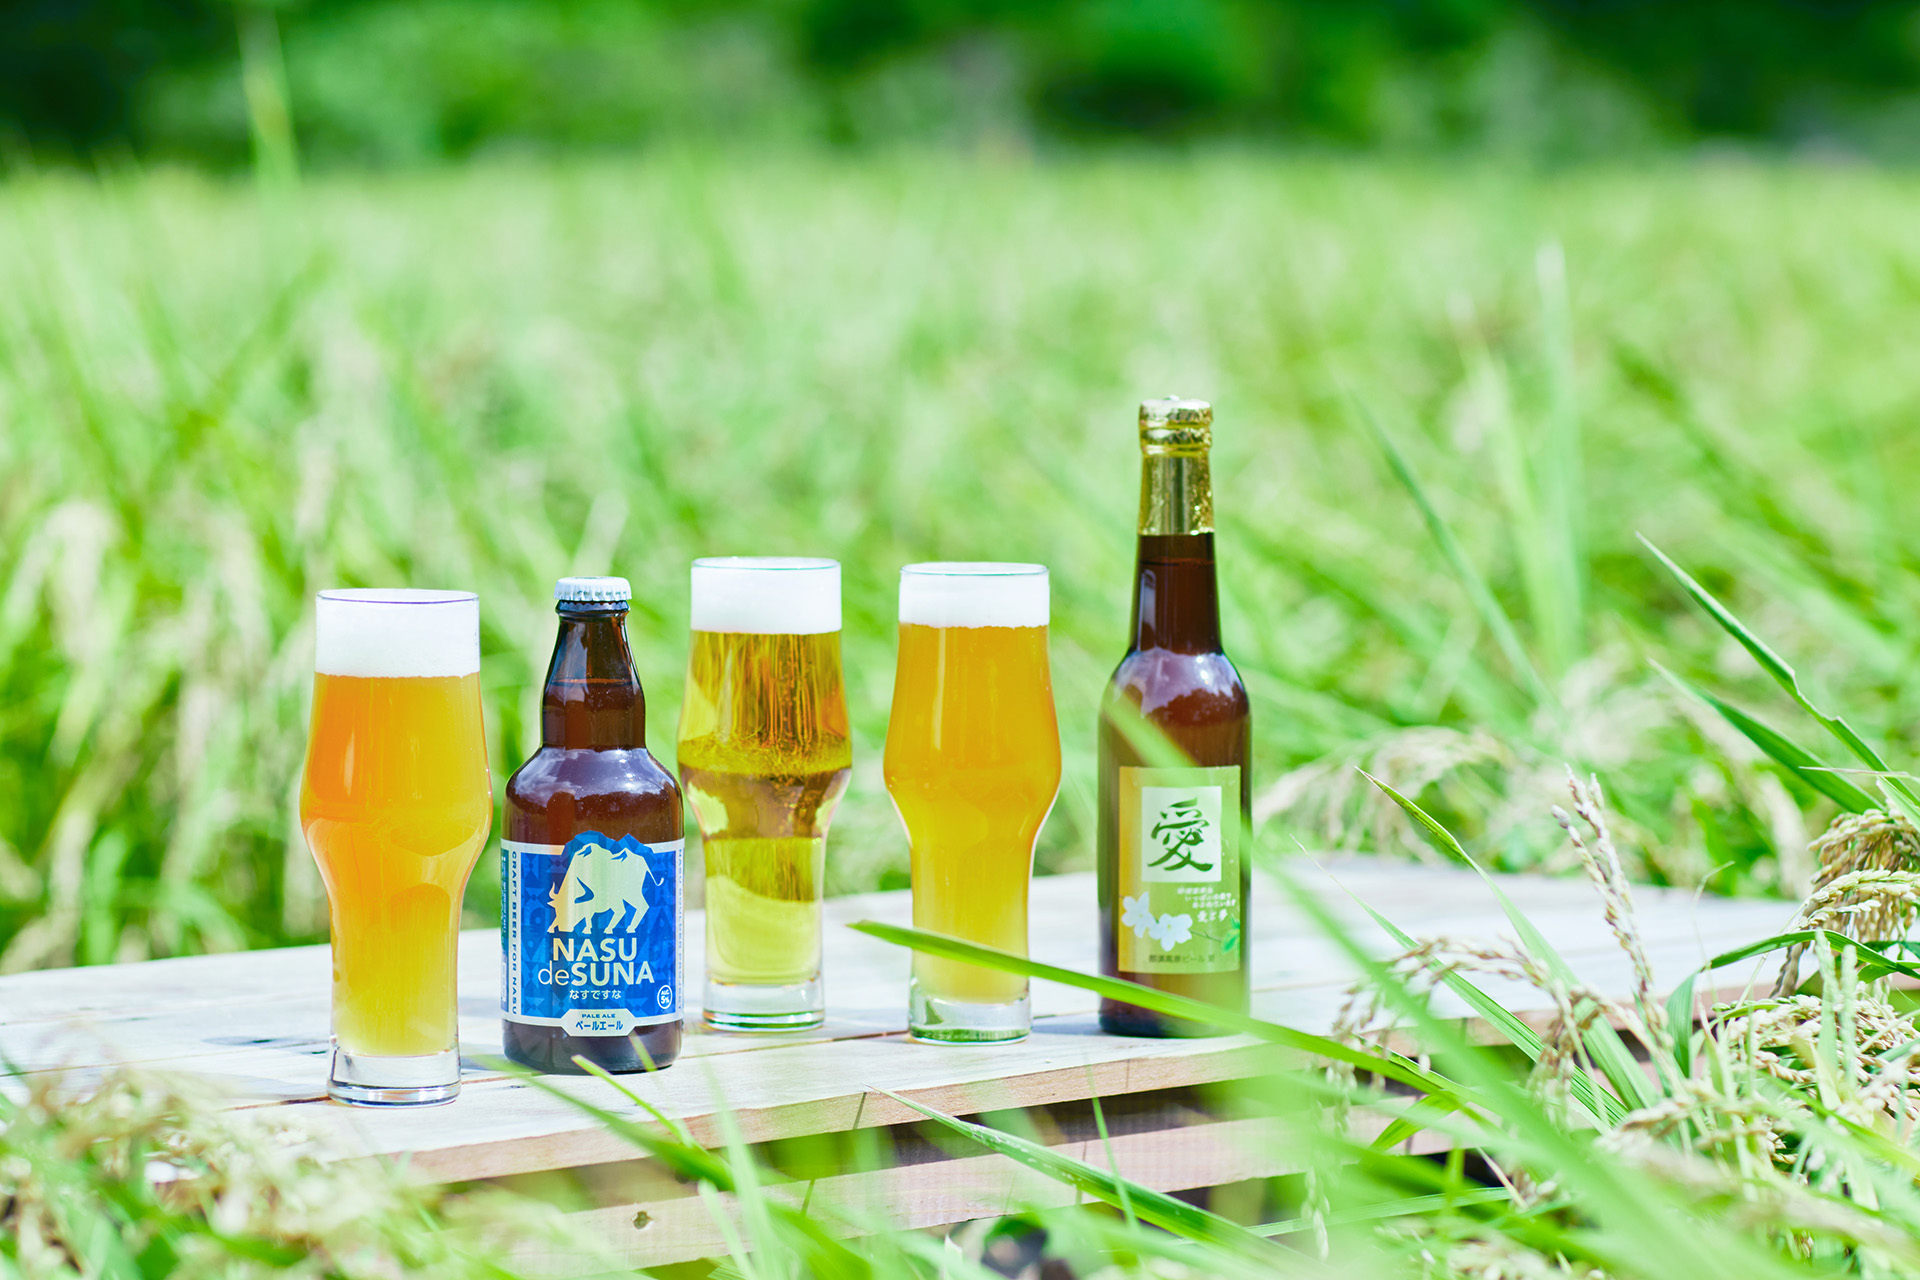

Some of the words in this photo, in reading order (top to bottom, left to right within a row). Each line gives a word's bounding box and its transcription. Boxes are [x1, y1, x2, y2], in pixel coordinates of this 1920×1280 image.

[1147, 796, 1214, 872] 愛
[552, 937, 637, 962] NASU
[538, 960, 655, 986] deSUNA
[569, 989, 622, 1000] なすですな
